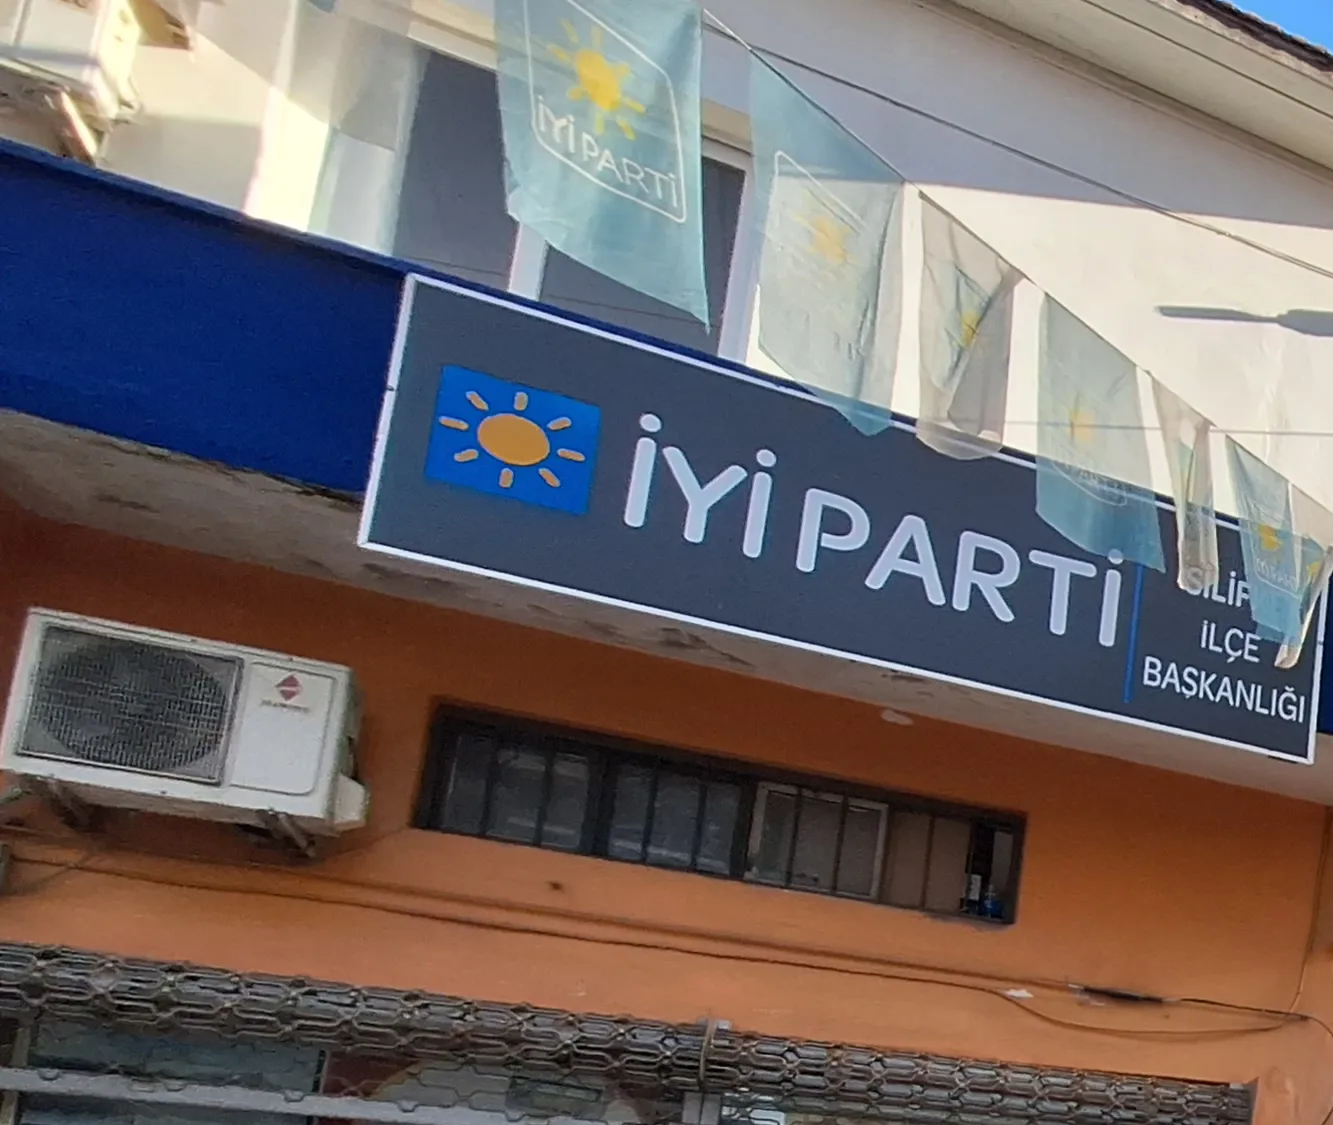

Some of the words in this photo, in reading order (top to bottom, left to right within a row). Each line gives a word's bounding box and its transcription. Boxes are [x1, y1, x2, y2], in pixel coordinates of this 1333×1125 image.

[537, 94, 576, 154] İYİ
[581, 130, 679, 208] PARTİ
[622, 412, 777, 559] İYİ
[796, 487, 1124, 648] PARTİ
[1200, 619, 1261, 664] İLÇE
[1142, 656, 1305, 724] BAŞKANLIĞI
